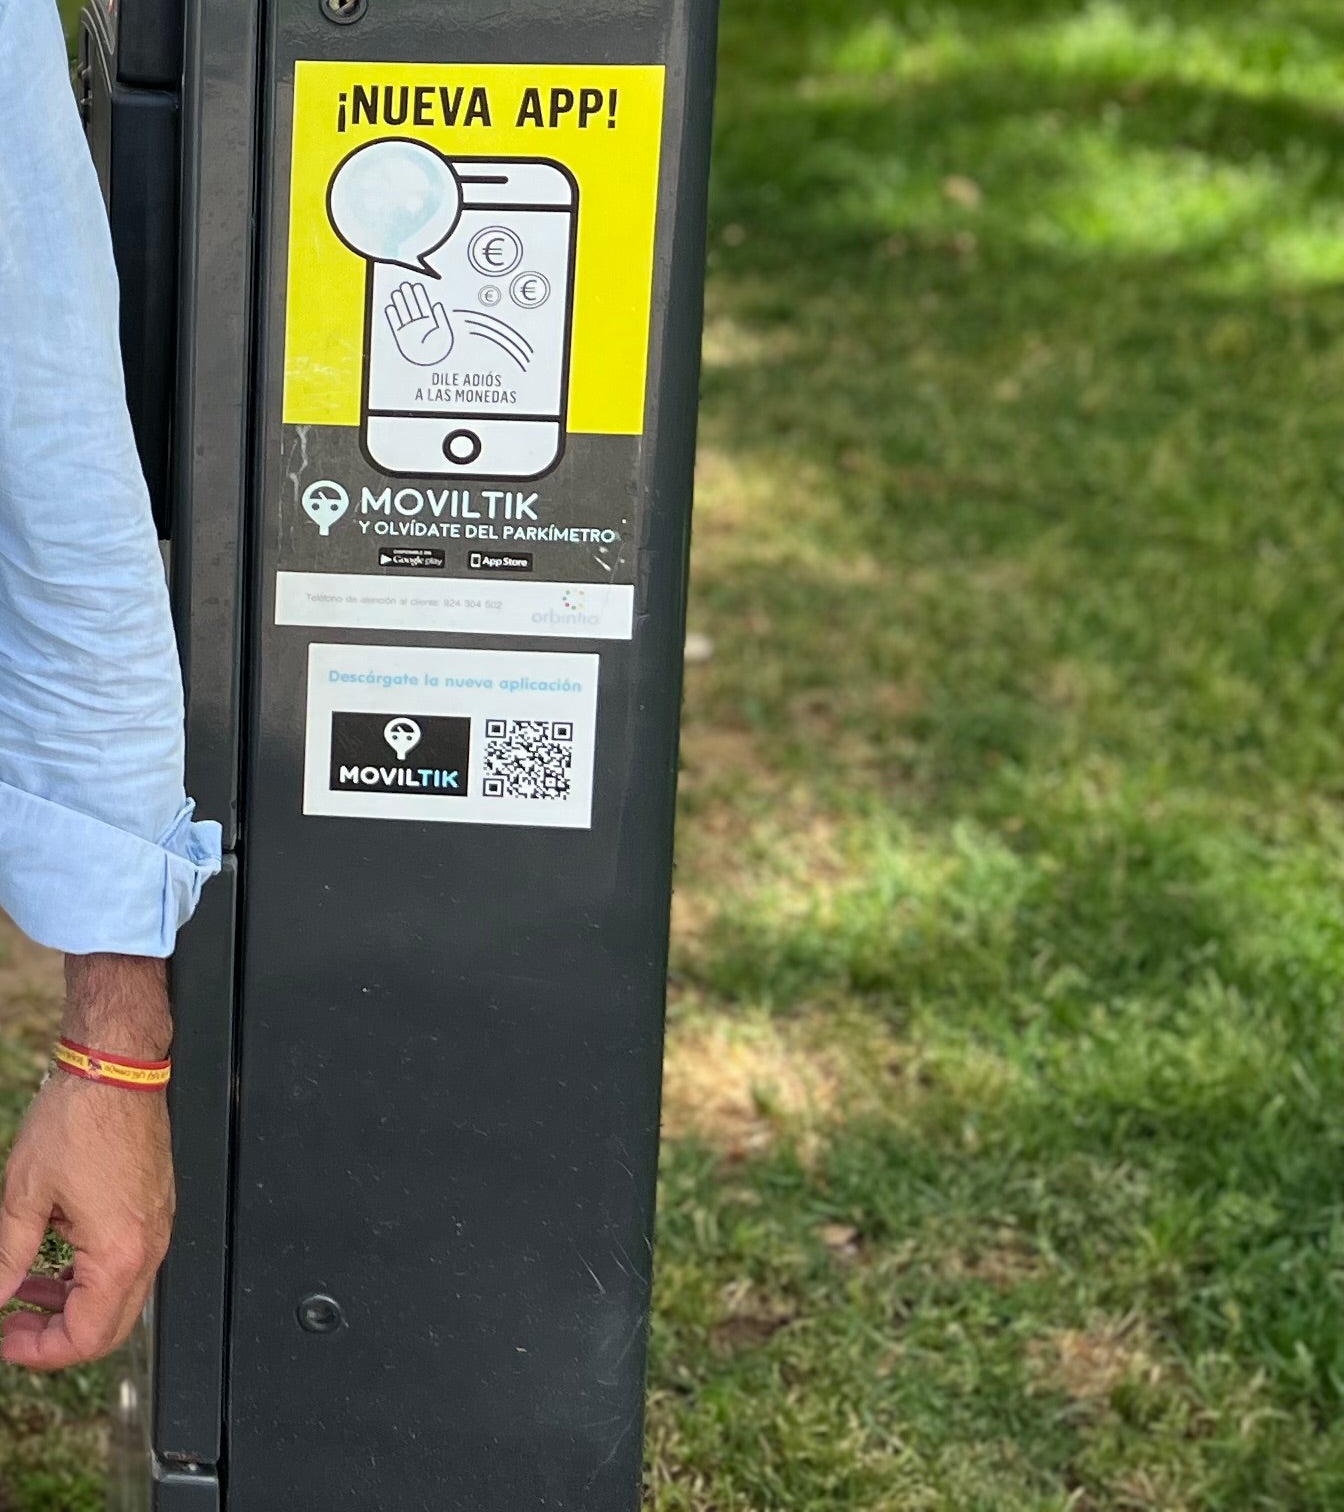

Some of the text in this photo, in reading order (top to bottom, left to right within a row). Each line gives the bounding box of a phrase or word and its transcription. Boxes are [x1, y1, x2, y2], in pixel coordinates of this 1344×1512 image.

[337, 84, 619, 133] ¡NUEVA APP!
[431, 371, 502, 387] DILE ADIÓS
[415, 388, 517, 404] A LAS MONEDAS
[361, 486, 539, 521] MOVILTIK
[359, 520, 616, 544] Y OLVÍDATE DEL PARKÍMETRO
[482, 557, 528, 567] App Store
[443, 599, 461, 608] 924
[464, 600, 482, 609] 304
[484, 600, 503, 610] 502
[328, 669, 583, 693] Descárgate la nueva aplicación
[339, 766, 460, 788] MOVILTIK
